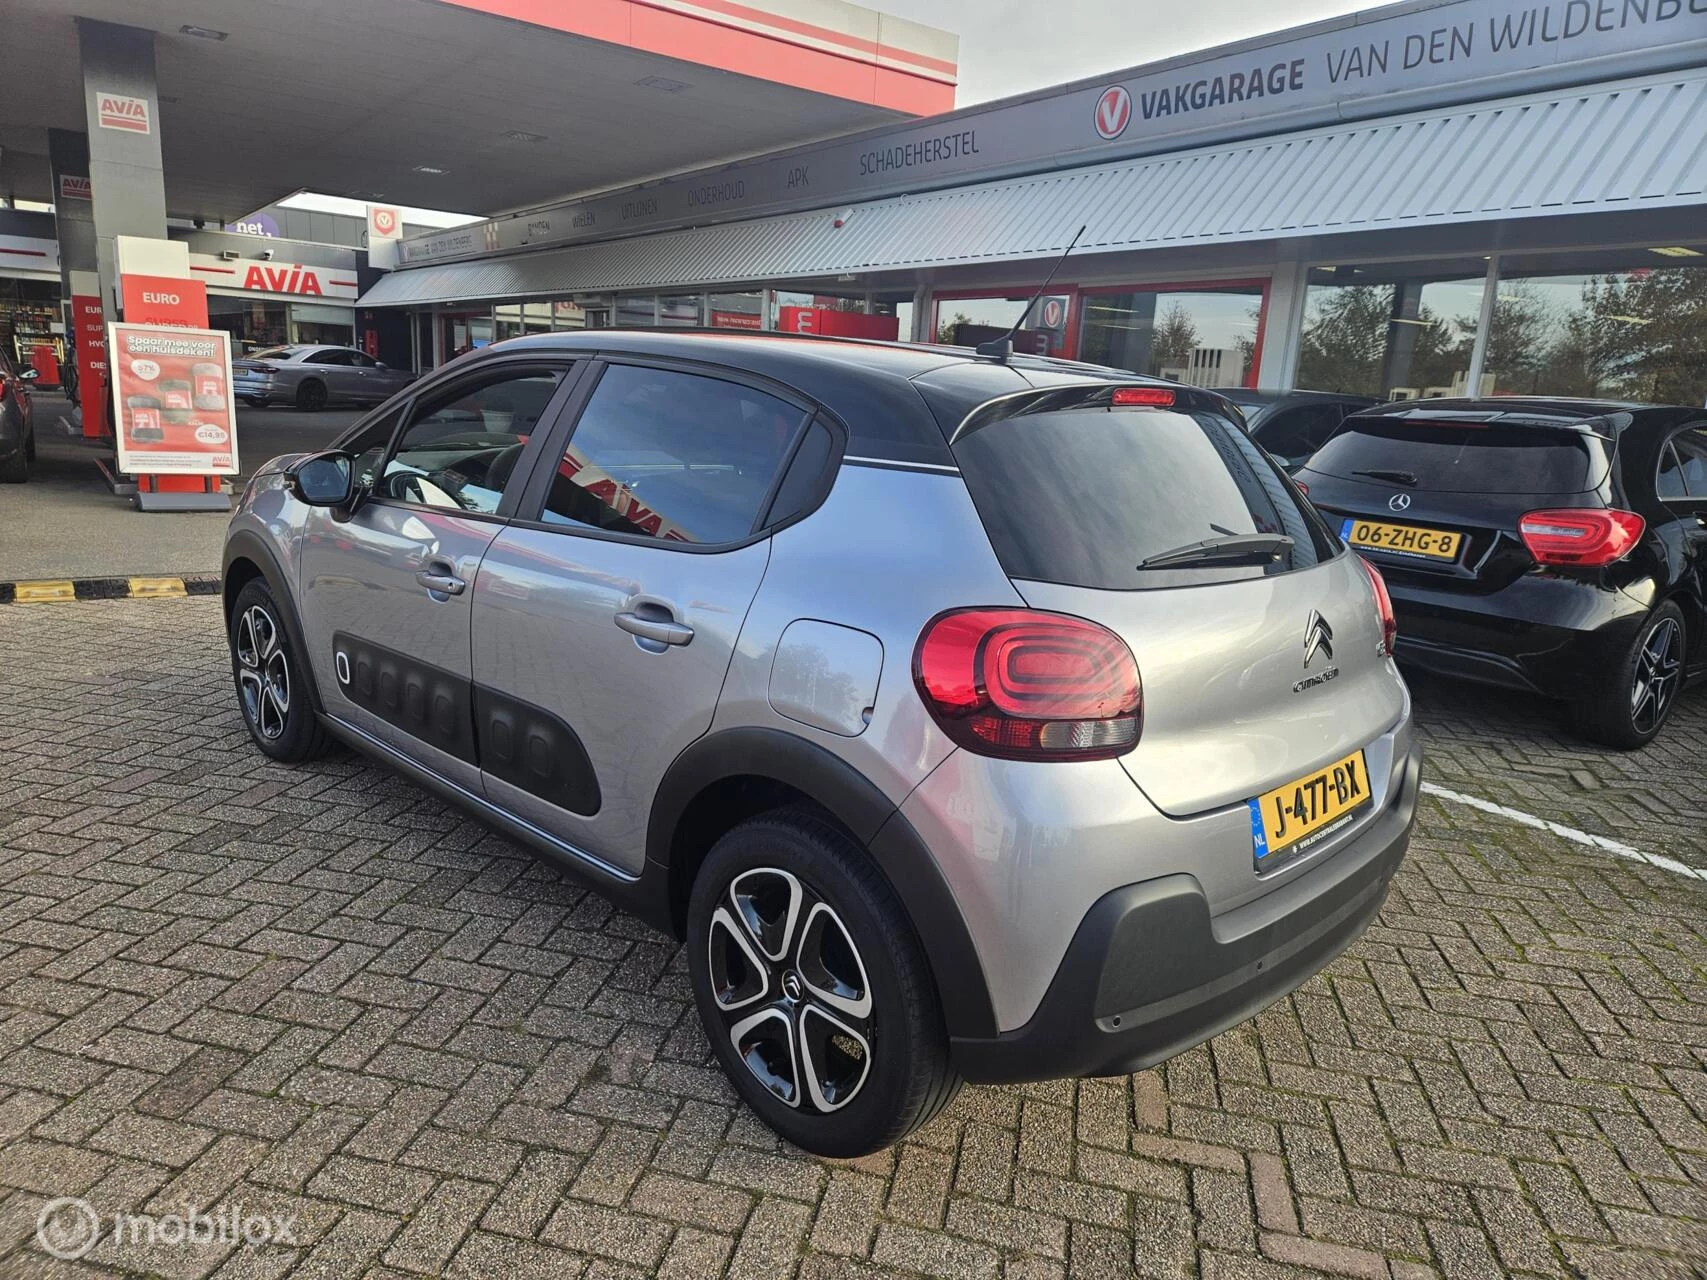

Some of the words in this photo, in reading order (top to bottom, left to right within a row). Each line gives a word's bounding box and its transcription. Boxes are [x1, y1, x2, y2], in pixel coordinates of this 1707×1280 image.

[1141, 61, 1304, 120] VAKGARAGE
[1327, 40, 1390, 83] VAN
[1402, 22, 1474, 70] DEN
[860, 130, 980, 176] SCHADEHERSTEL
[787, 166, 809, 189] APK
[687, 180, 745, 207] ONDERHOUD
[142, 292, 180, 305] EURO
[128, 335, 161, 347] Spaar
[164, 339, 189, 347] mee
[191, 341, 216, 349] voor
[129, 345, 150, 353] een
[1356, 524, 1453, 553] 06-ZHG-8
[1275, 760, 1361, 838] J-477-BX
[1253, 833, 1266, 848] NL
